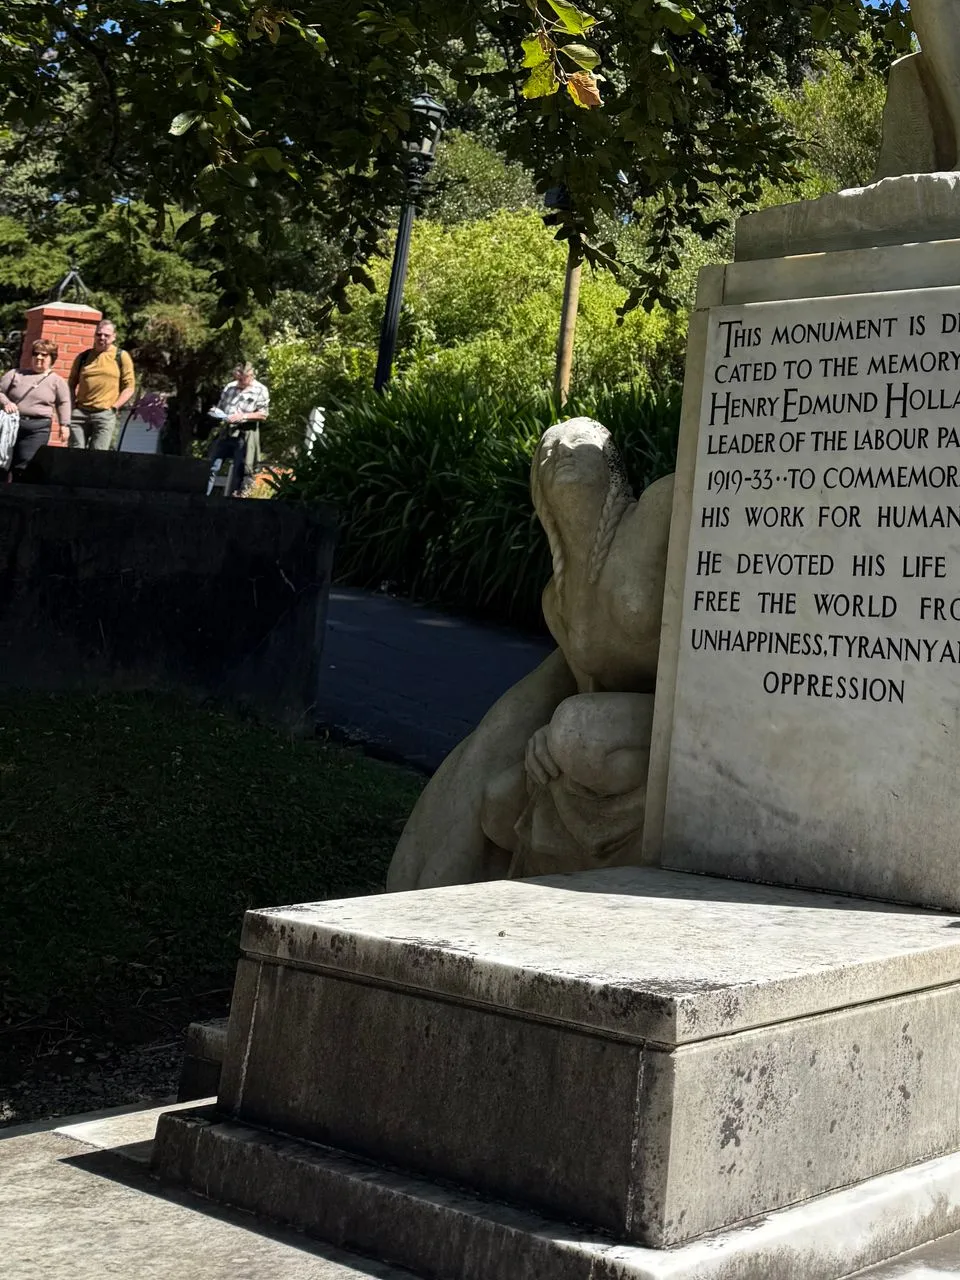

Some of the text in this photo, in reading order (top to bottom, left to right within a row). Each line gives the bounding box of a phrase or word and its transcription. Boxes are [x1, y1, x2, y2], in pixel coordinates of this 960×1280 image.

[718, 320, 761, 358] THIS
[771, 317, 898, 345] MONUMENT
[910, 315, 925, 336] IS
[715, 362, 777, 384] CATED
[783, 359, 812, 379] TO
[819, 356, 859, 377] THE
[708, 392, 779, 426] HENRY
[781, 388, 878, 423] EDMUND
[707, 433, 775, 455] LEADER
[779, 432, 806, 453] OF
[811, 431, 848, 451] THE
[854, 428, 929, 450] LABOUR
[701, 506, 729, 527] HIS
[745, 506, 805, 527] WORK
[819, 506, 861, 527] FOR
[696, 551, 722, 576] HE
[737, 554, 834, 576] DEVOTED
[853, 555, 885, 576] HIS
[902, 556, 946, 578] LIFE
[694, 591, 740, 612] FREE
[758, 592, 796, 615] THE
[814, 594, 897, 618] WORLD
[763, 671, 904, 704] OPPRESSION
